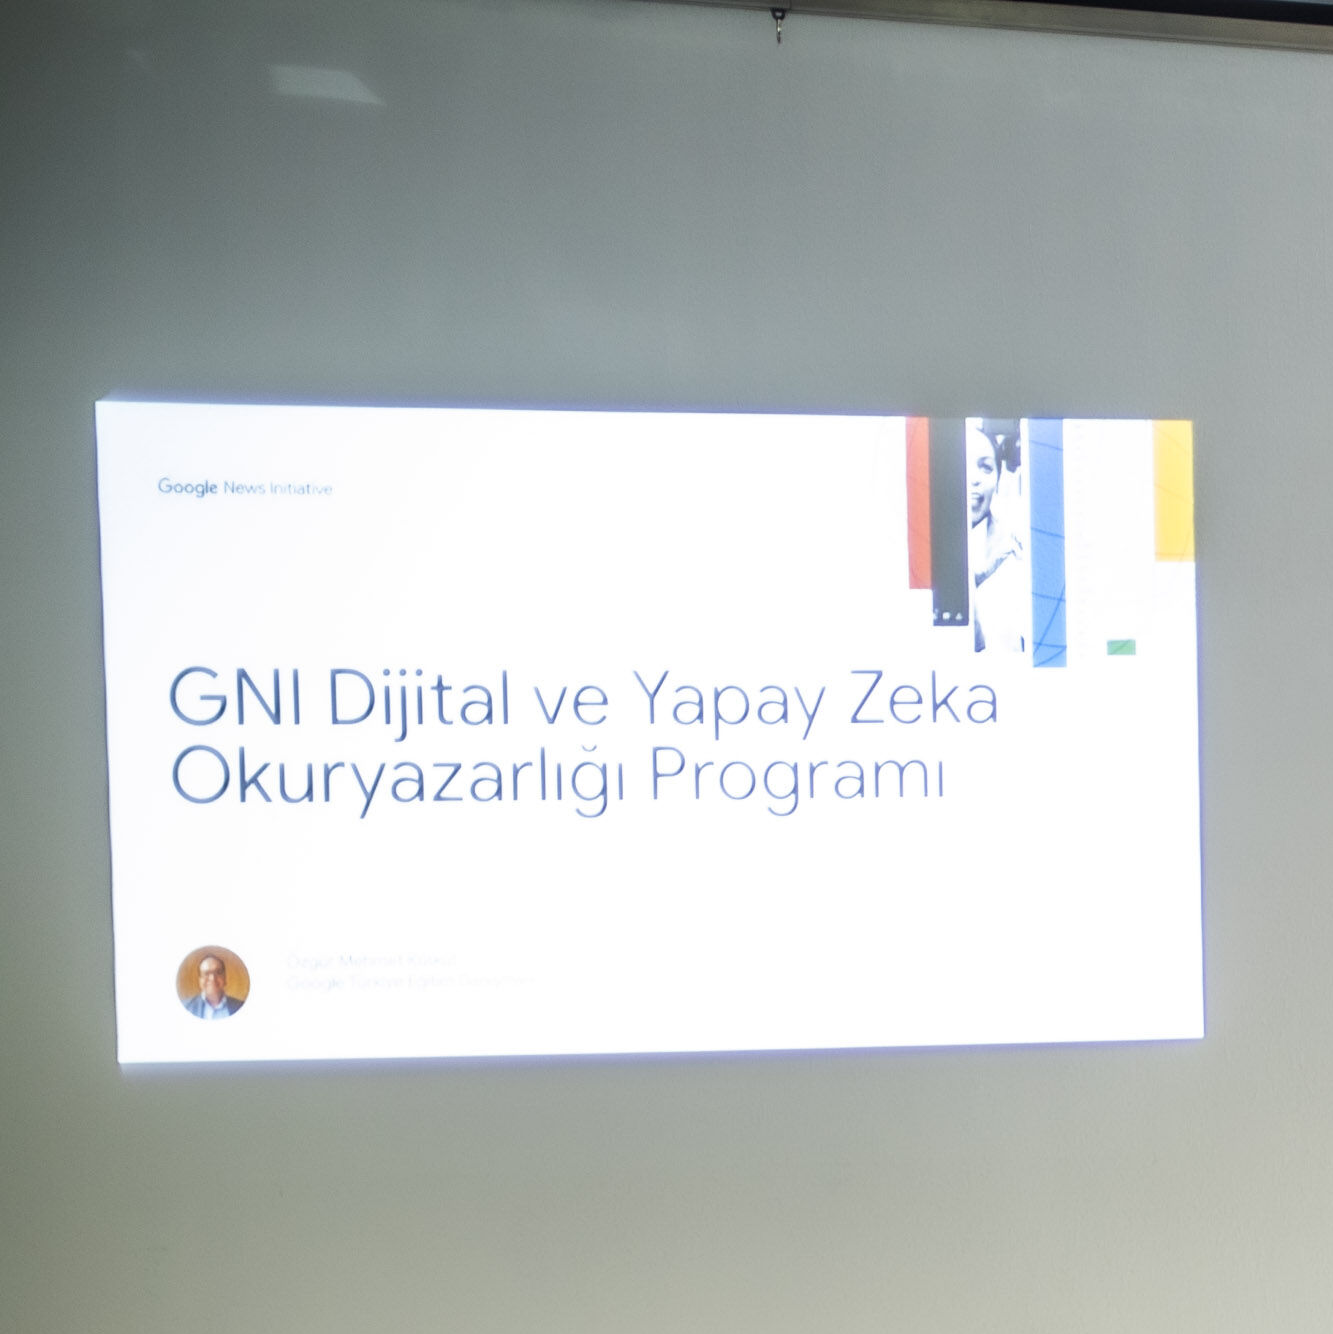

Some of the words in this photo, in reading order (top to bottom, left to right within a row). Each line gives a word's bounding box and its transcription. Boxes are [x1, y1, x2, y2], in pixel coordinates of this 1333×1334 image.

[157, 476, 218, 499] Google
[223, 480, 266, 495] News
[269, 481, 333, 495] Initiative
[169, 665, 301, 727] GNI
[329, 667, 509, 743] Dijital
[534, 685, 609, 726] ve
[633, 669, 826, 741] Yapay
[850, 669, 998, 725] Zeka
[171, 744, 624, 819] Okuryazarlığı
[652, 746, 944, 817] Programı
